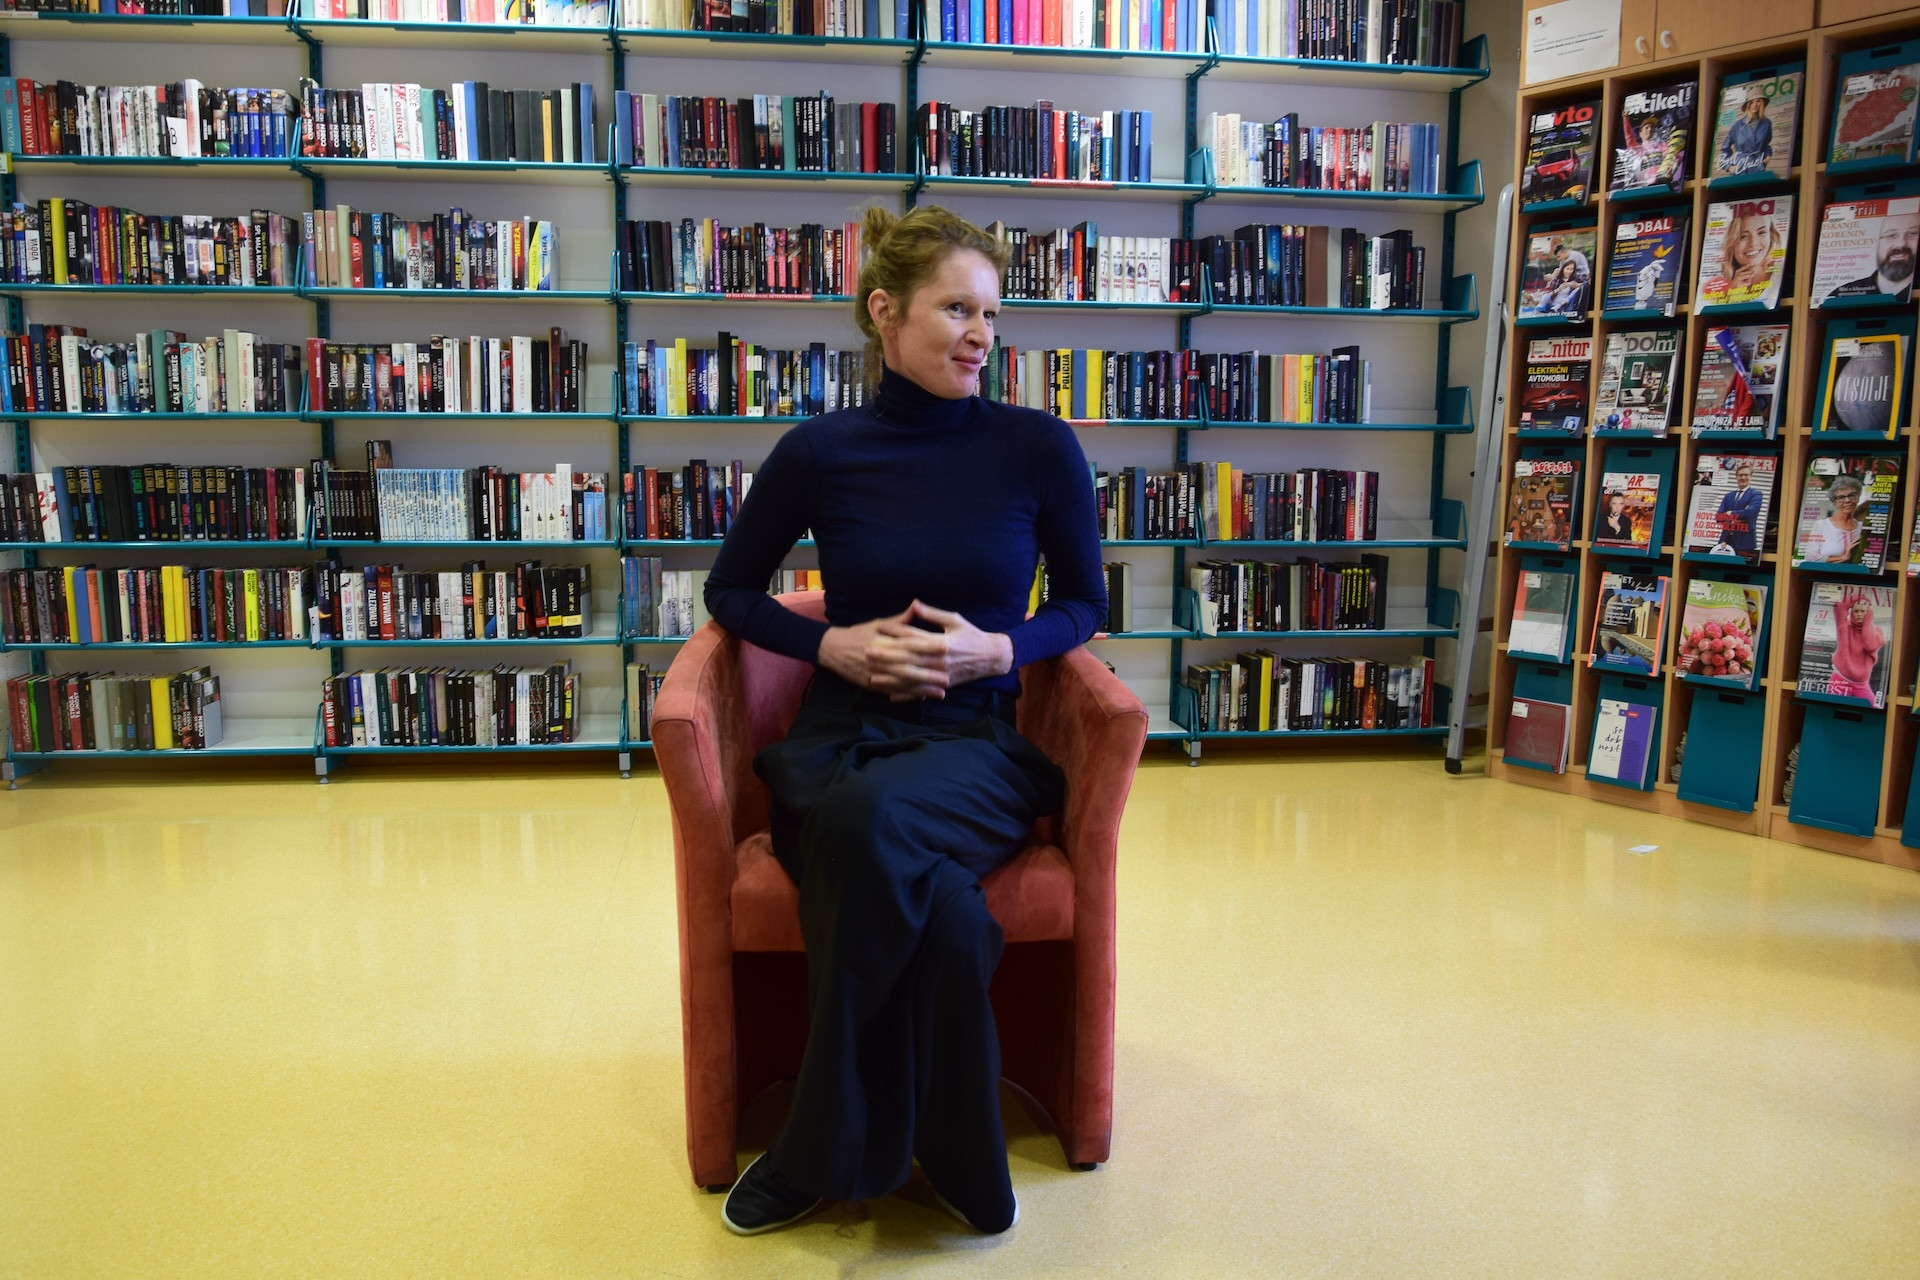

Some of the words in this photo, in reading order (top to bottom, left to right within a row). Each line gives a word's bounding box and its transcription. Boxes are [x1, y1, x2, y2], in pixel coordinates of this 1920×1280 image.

[23, 108, 35, 149] KOMORA
[395, 101, 404, 139] OBEŠENEC
[368, 114, 377, 152] KONČNICA
[373, 218, 381, 235] CSI:
[1637, 220, 1671, 234] OBAL
[1822, 229, 1866, 239] KORENIN
[1823, 221, 1859, 230] ISKANJE
[31, 238, 39, 261] VDOVA
[68, 231, 76, 258] PREVARAN
[513, 227, 521, 257] MREŽA
[539, 235, 548, 257] IGRA
[1820, 238, 1875, 248] SLOVENCEV
[1530, 339, 1590, 359] nitor
[36, 366, 44, 388] BROWN
[52, 367, 60, 389] BROWN
[171, 355, 179, 383] MORILEC
[328, 362, 339, 388] Deaver
[345, 362, 355, 388] Deaver
[362, 363, 372, 389] Deaver
[380, 363, 389, 389] Deaver
[1062, 354, 1070, 390] POLICIJA
[1528, 365, 1568, 375] ELEKTRIČNI
[1528, 374, 1569, 383] AVTOMOBILI
[172, 392, 180, 404] ČAS
[1178, 475, 1188, 514] Patterson
[367, 588, 378, 627] ZALEZOVALCI
[325, 701, 335, 717] LOVU
[326, 718, 336, 727] NA
